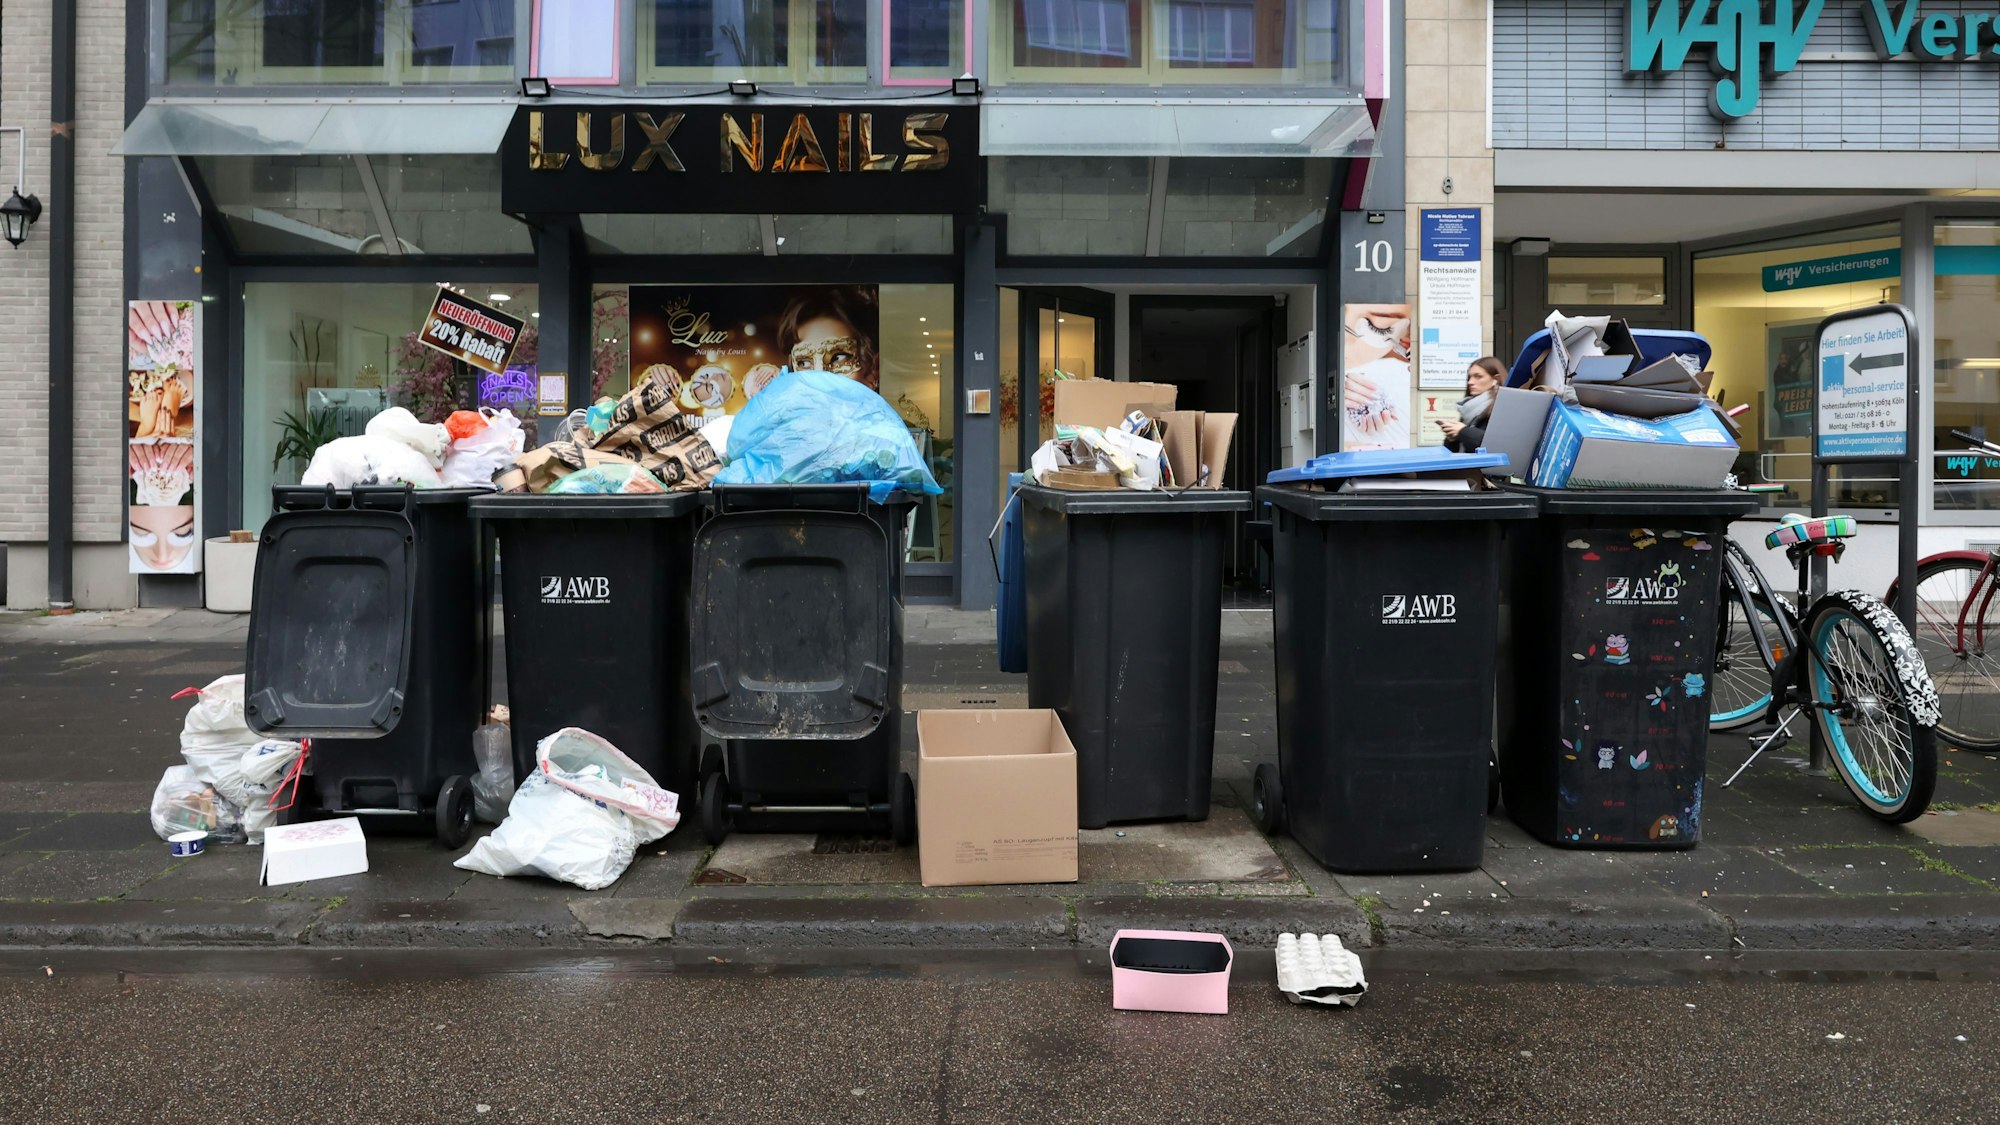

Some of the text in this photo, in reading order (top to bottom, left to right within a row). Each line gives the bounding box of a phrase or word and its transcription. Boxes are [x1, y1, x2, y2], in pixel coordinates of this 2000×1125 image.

[529, 112, 950, 172] LUX NAILS
[1442, 176, 1454, 194] 8
[1355, 240, 1393, 272] 10
[1808, 256, 1889, 275] Versicherungen
[437, 299, 515, 344] NEUERÖFFNUNG
[668, 312, 728, 348] Lux
[429, 319, 506, 364] 20% Rabatt
[1821, 327, 1905, 350] Hier finden Sie Arbeit!
[716, 348, 726, 356] by
[489, 372, 524, 388] NAILS
[1842, 380, 1905, 398] personal-service
[490, 391, 524, 403] OPEN
[1778, 388, 1806, 402] PREIS
[1821, 397, 1905, 410] Hohenstaufenring 8 50674 Köln
[1784, 400, 1812, 413] LEIST
[1867, 410, 1875, 418] 08
[647, 415, 692, 448] GORILLA
[1828, 423, 1848, 431] Montag
[1851, 421, 1871, 430] Freitag:
[1871, 420, 1875, 428] 8
[1823, 436, 1903, 446] www.aktivpersonalservice.de
[1984, 457, 2000, 468] Ve
[564, 576, 610, 598] AWB
[1408, 595, 1456, 617] AWB
